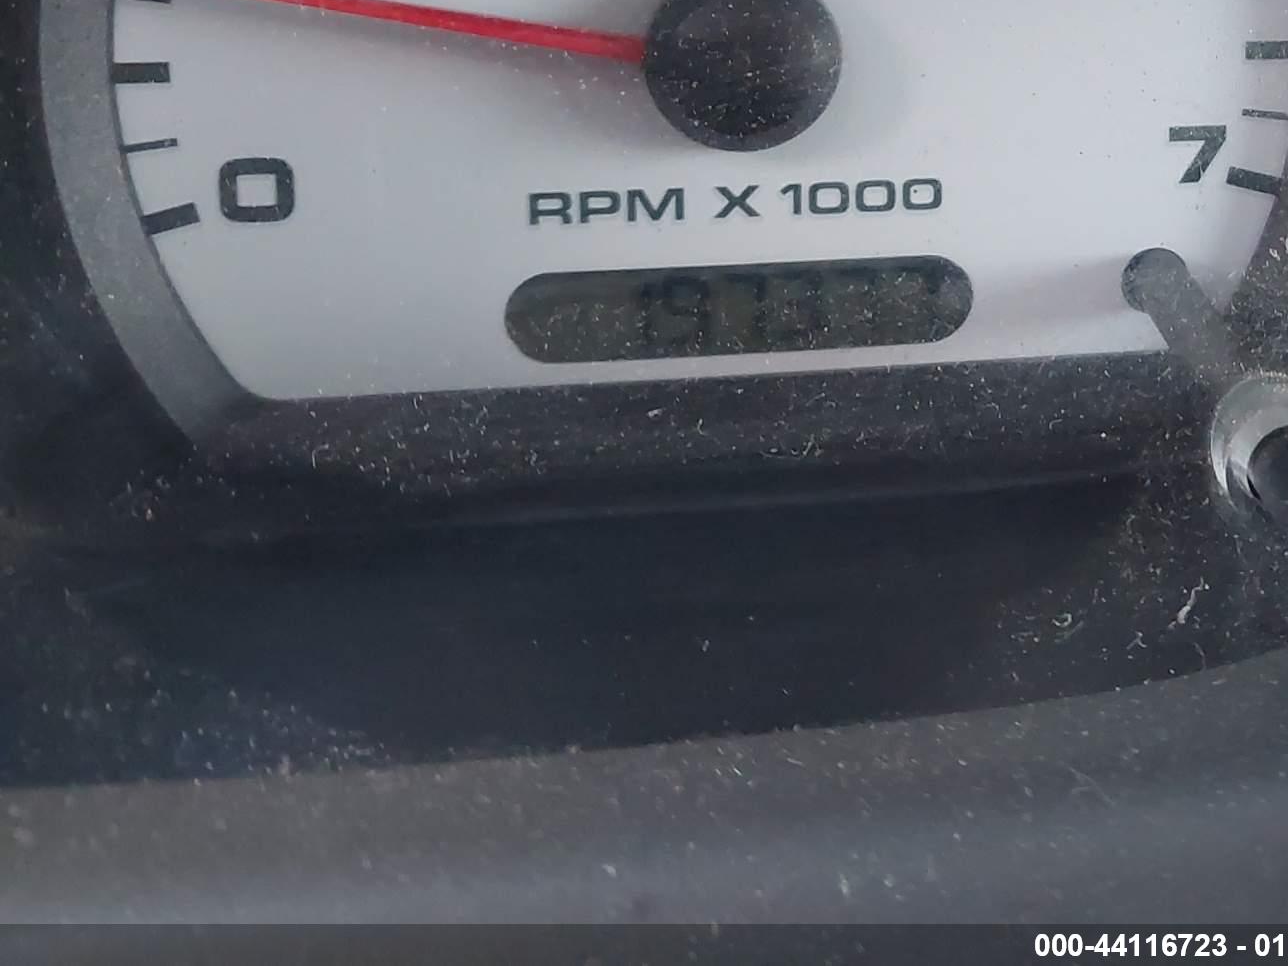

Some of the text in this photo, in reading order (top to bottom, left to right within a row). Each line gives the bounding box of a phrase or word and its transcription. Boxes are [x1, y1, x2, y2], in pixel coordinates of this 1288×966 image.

[1168, 125, 1227, 184] 7
[218, 157, 295, 223] 0
[528, 177, 943, 226] RPM X 1000
